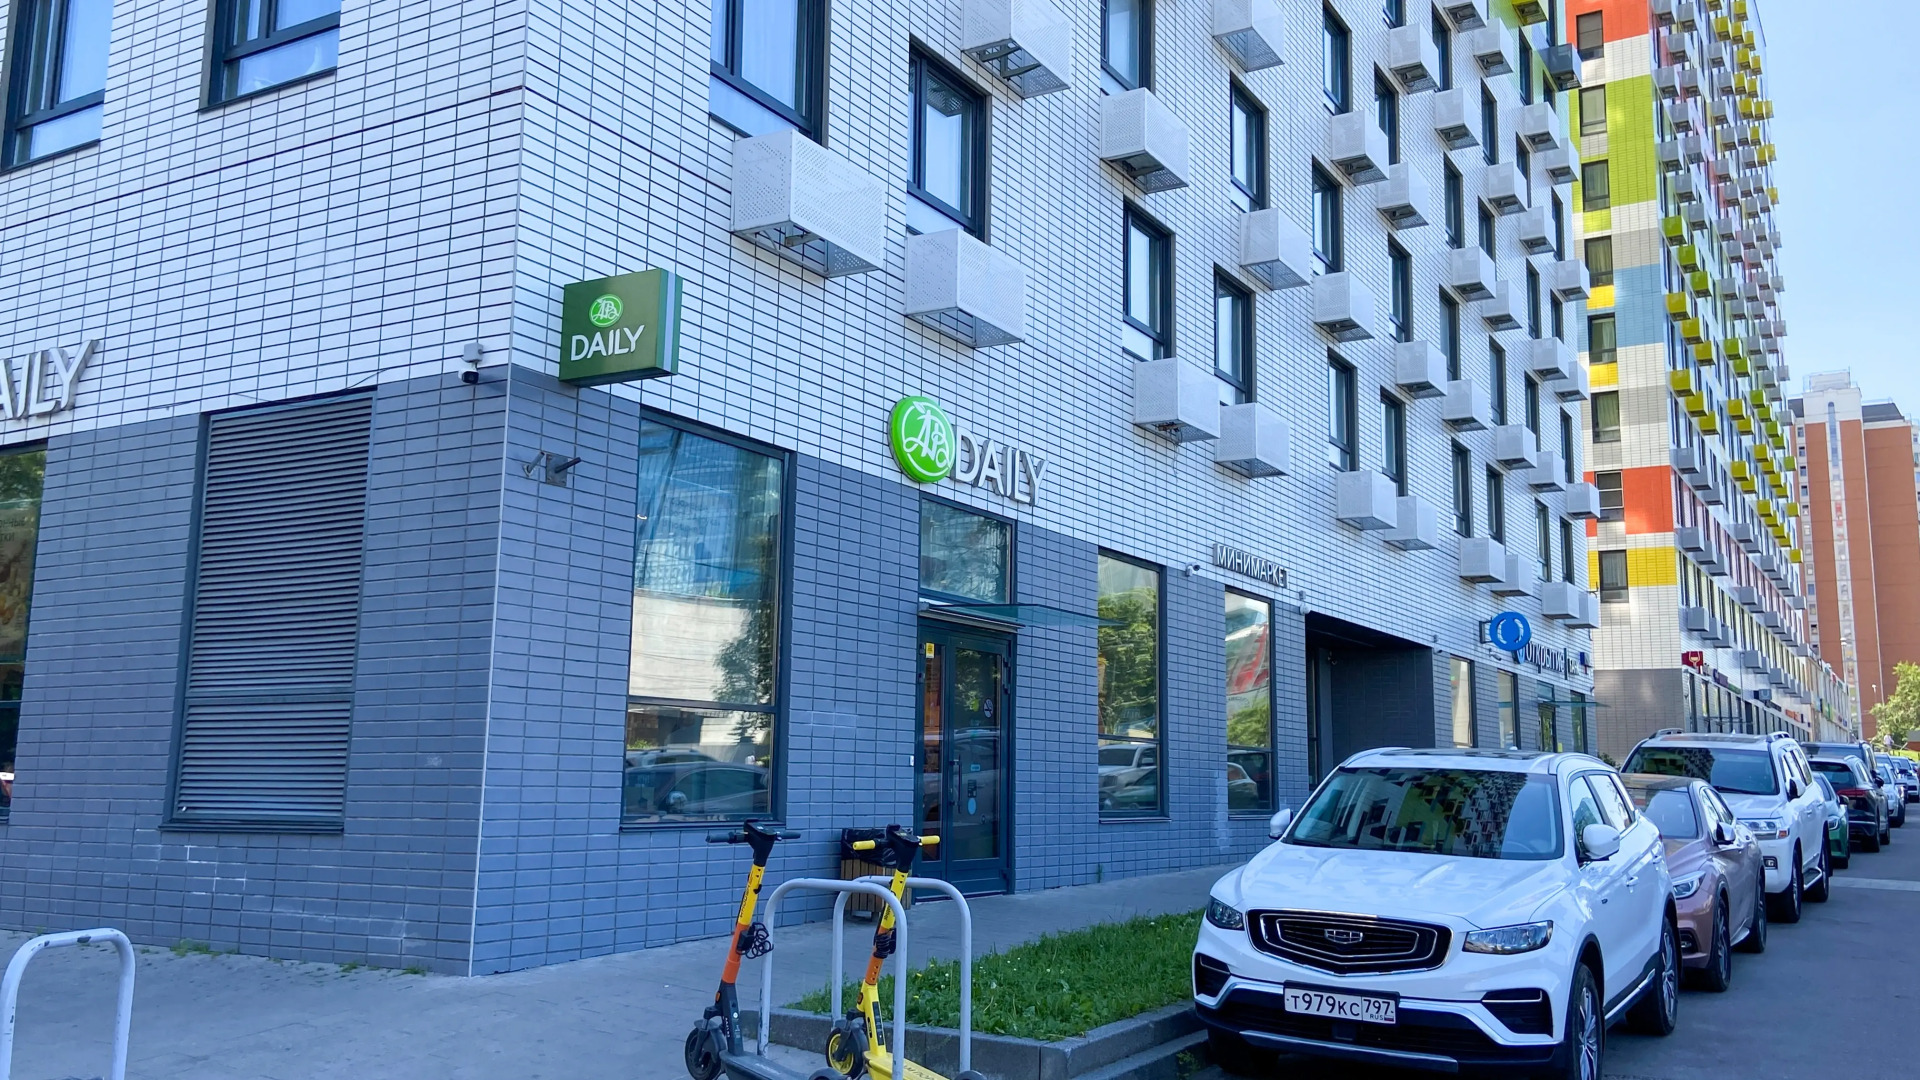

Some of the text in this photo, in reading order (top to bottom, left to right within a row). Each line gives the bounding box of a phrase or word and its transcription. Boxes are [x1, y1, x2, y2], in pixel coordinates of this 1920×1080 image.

[570, 324, 645, 361] DAILY
[954, 425, 1049, 506] DAILY
[1215, 544, 1290, 588] МИНИМАРКЕТ
[1363, 998, 1391, 1015] 797
[1370, 1013, 1384, 1021] RUS
